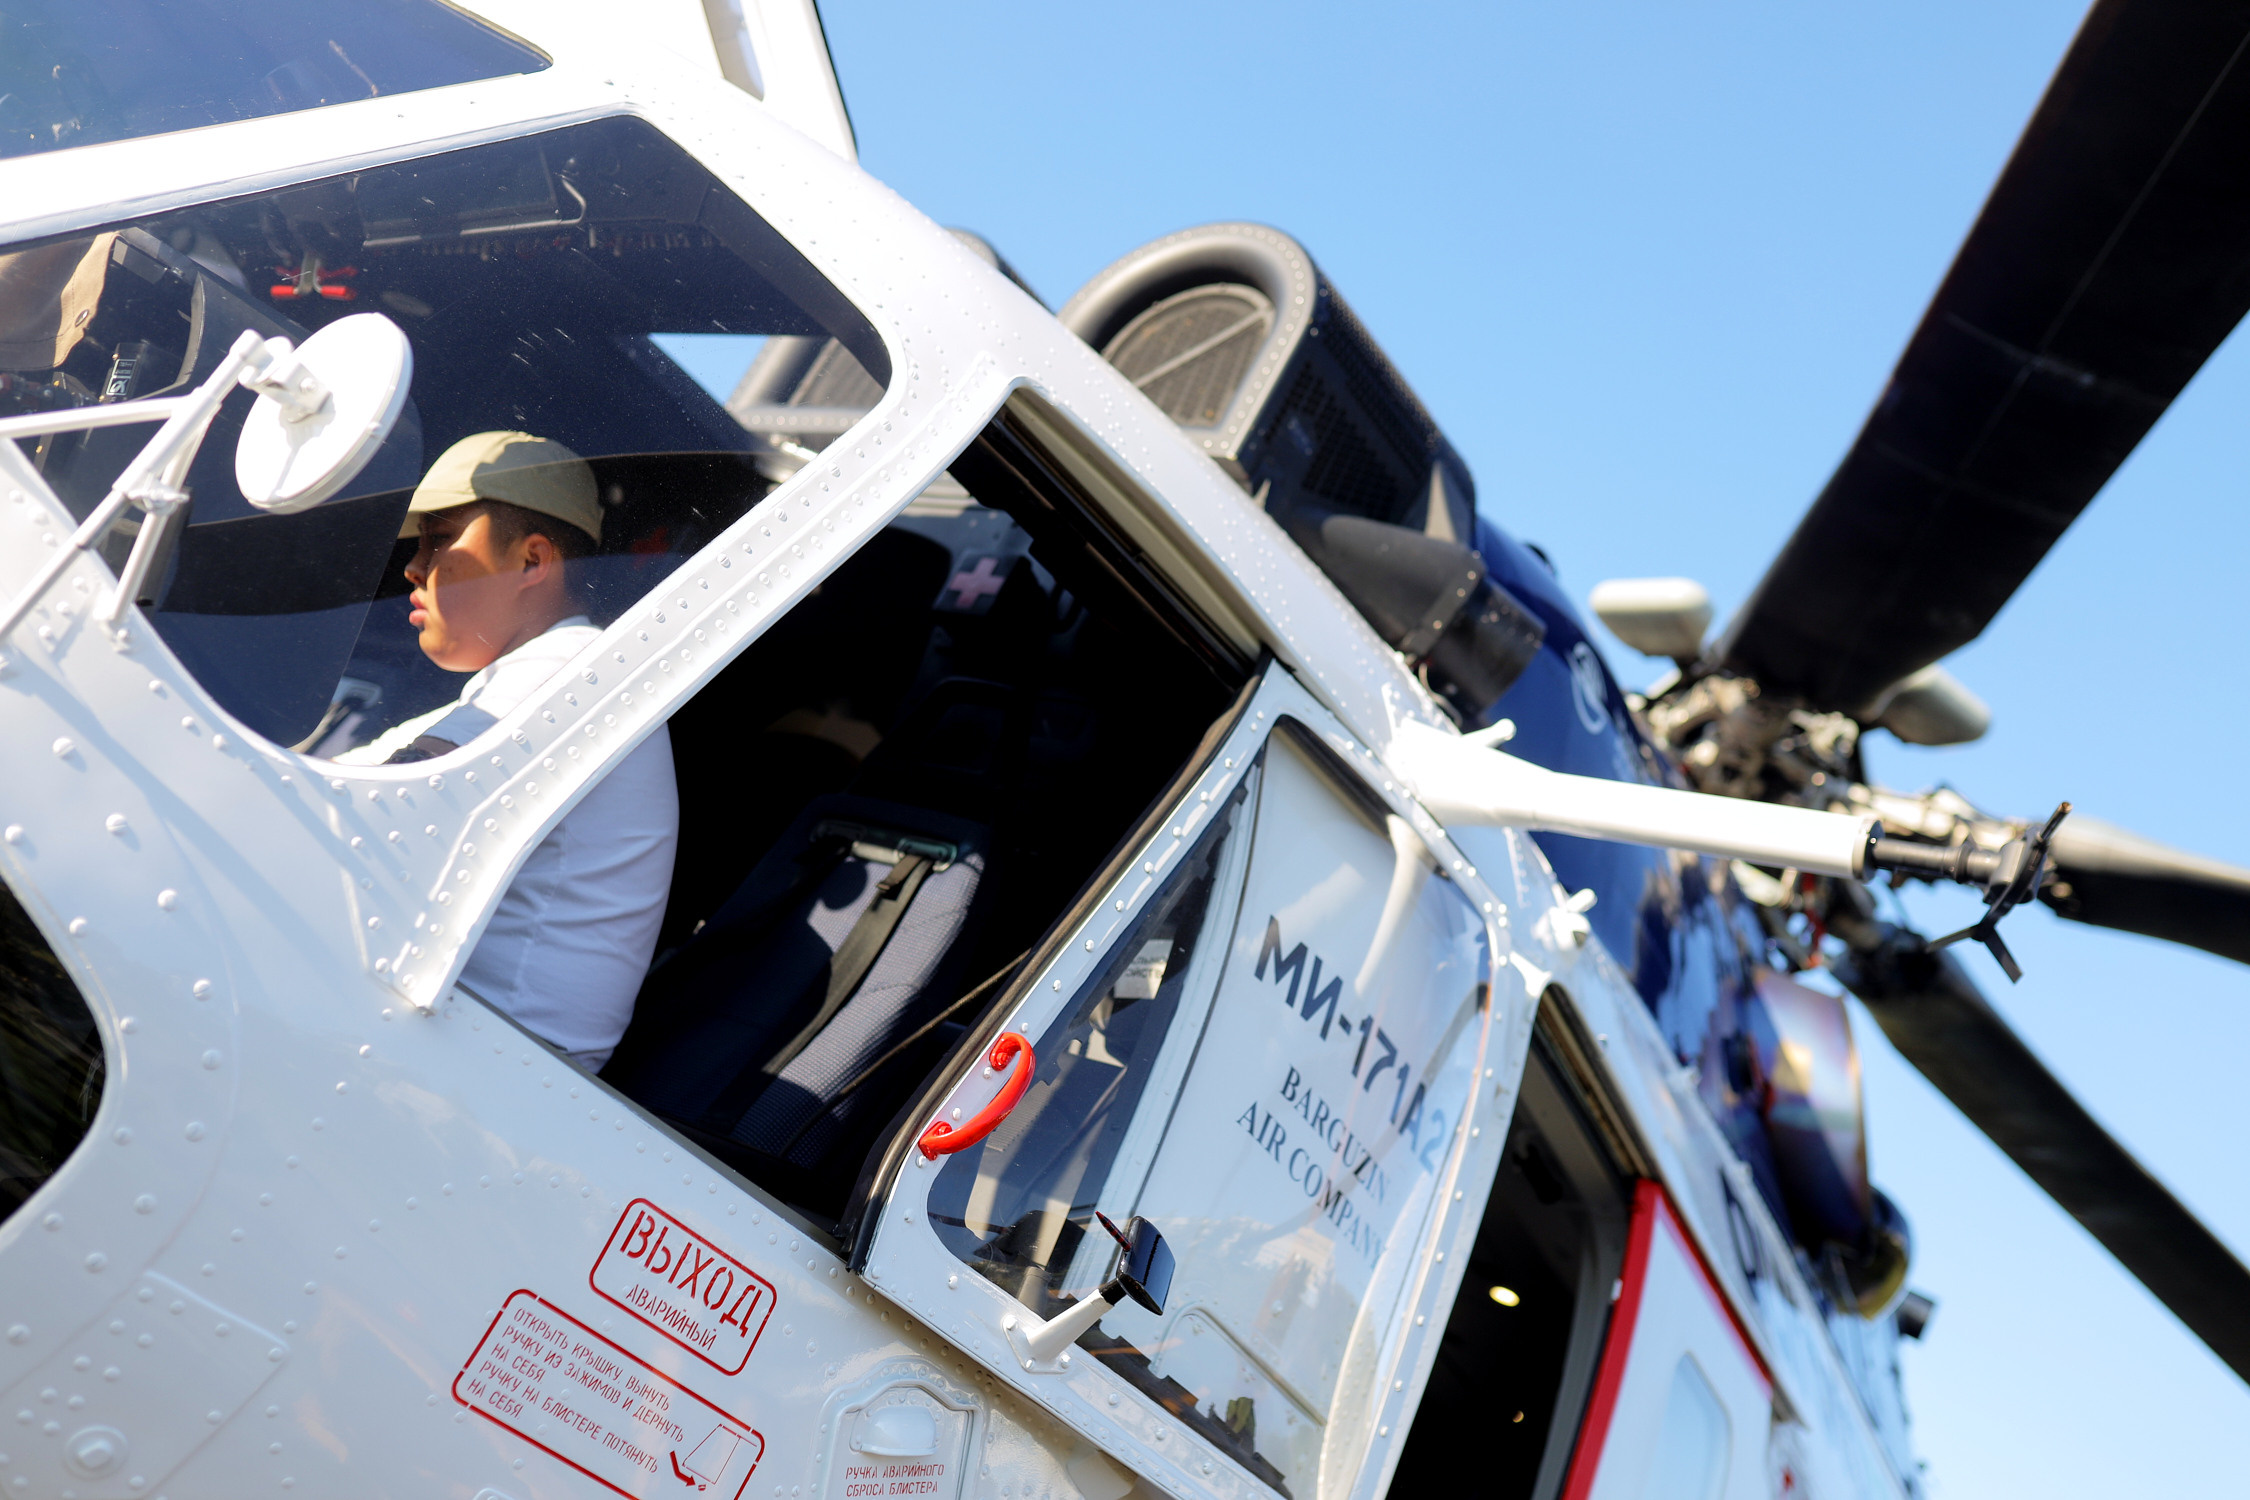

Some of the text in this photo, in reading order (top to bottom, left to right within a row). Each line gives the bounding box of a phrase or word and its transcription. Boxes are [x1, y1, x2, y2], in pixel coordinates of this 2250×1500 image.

[1254, 914, 1446, 1175] МИ-171А2
[1236, 1101, 1387, 1272] AIR COMPANY
[1280, 1064, 1390, 1206] BARGUZIN
[619, 1209, 762, 1338] ВЫХОД
[625, 1283, 717, 1351] АВАРИЙНЫЙ
[467, 1378, 487, 1398] НА
[491, 1343, 546, 1384] НА СЕБЯ.
[502, 1325, 684, 1443] РУЧКУ ИЗ ЗАЖИМОВ И ДЕРНУТЬ
[513, 1308, 568, 1349] ОТКРЫТЬ
[625, 1375, 670, 1411] ВЫНУТЬ
[479, 1360, 658, 1473] РУЧКУ НА БЛИСТЕРЕ ПОТЯНУТЬ
[845, 1462, 944, 1480] РУЧКА АВАРИЙНОГО
[846, 1481, 938, 1497] СБРОСА БЛИСТЕРА
